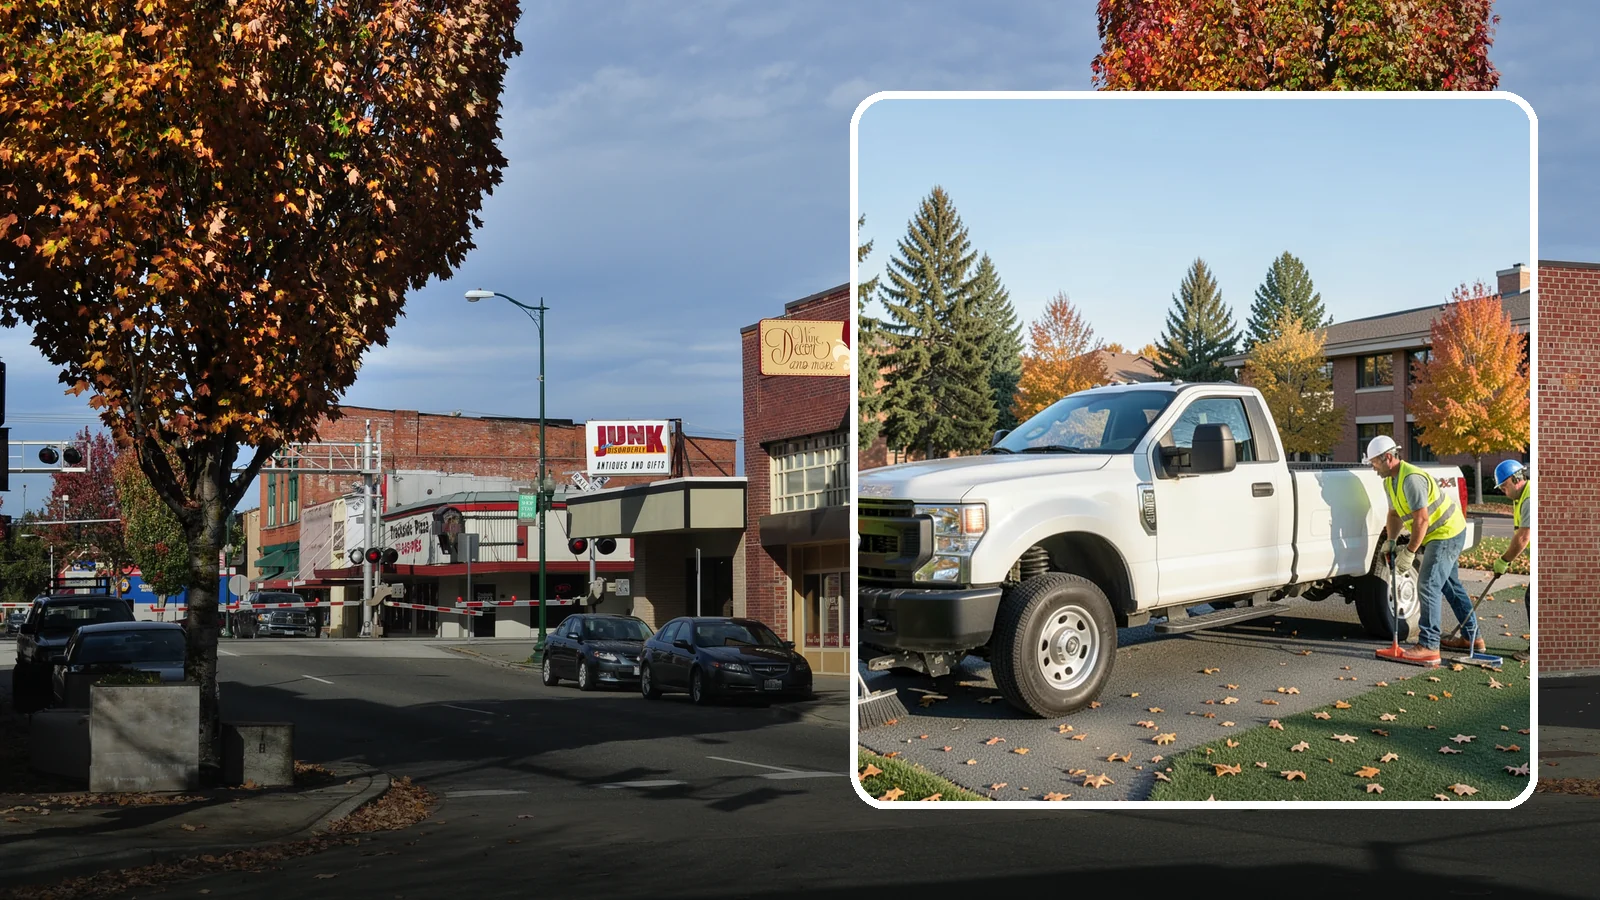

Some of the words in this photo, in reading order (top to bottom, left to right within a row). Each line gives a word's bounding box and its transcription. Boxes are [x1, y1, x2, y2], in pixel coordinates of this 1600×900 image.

[765, 328, 831, 365] Decor
[595, 425, 665, 457] JUNK
[607, 446, 646, 454] DISORDERLY
[597, 461, 628, 470] ANTIQUES
[631, 461, 644, 470] AND
[647, 460, 665, 469] GIFTS
[414, 519, 429, 535] Pizza
